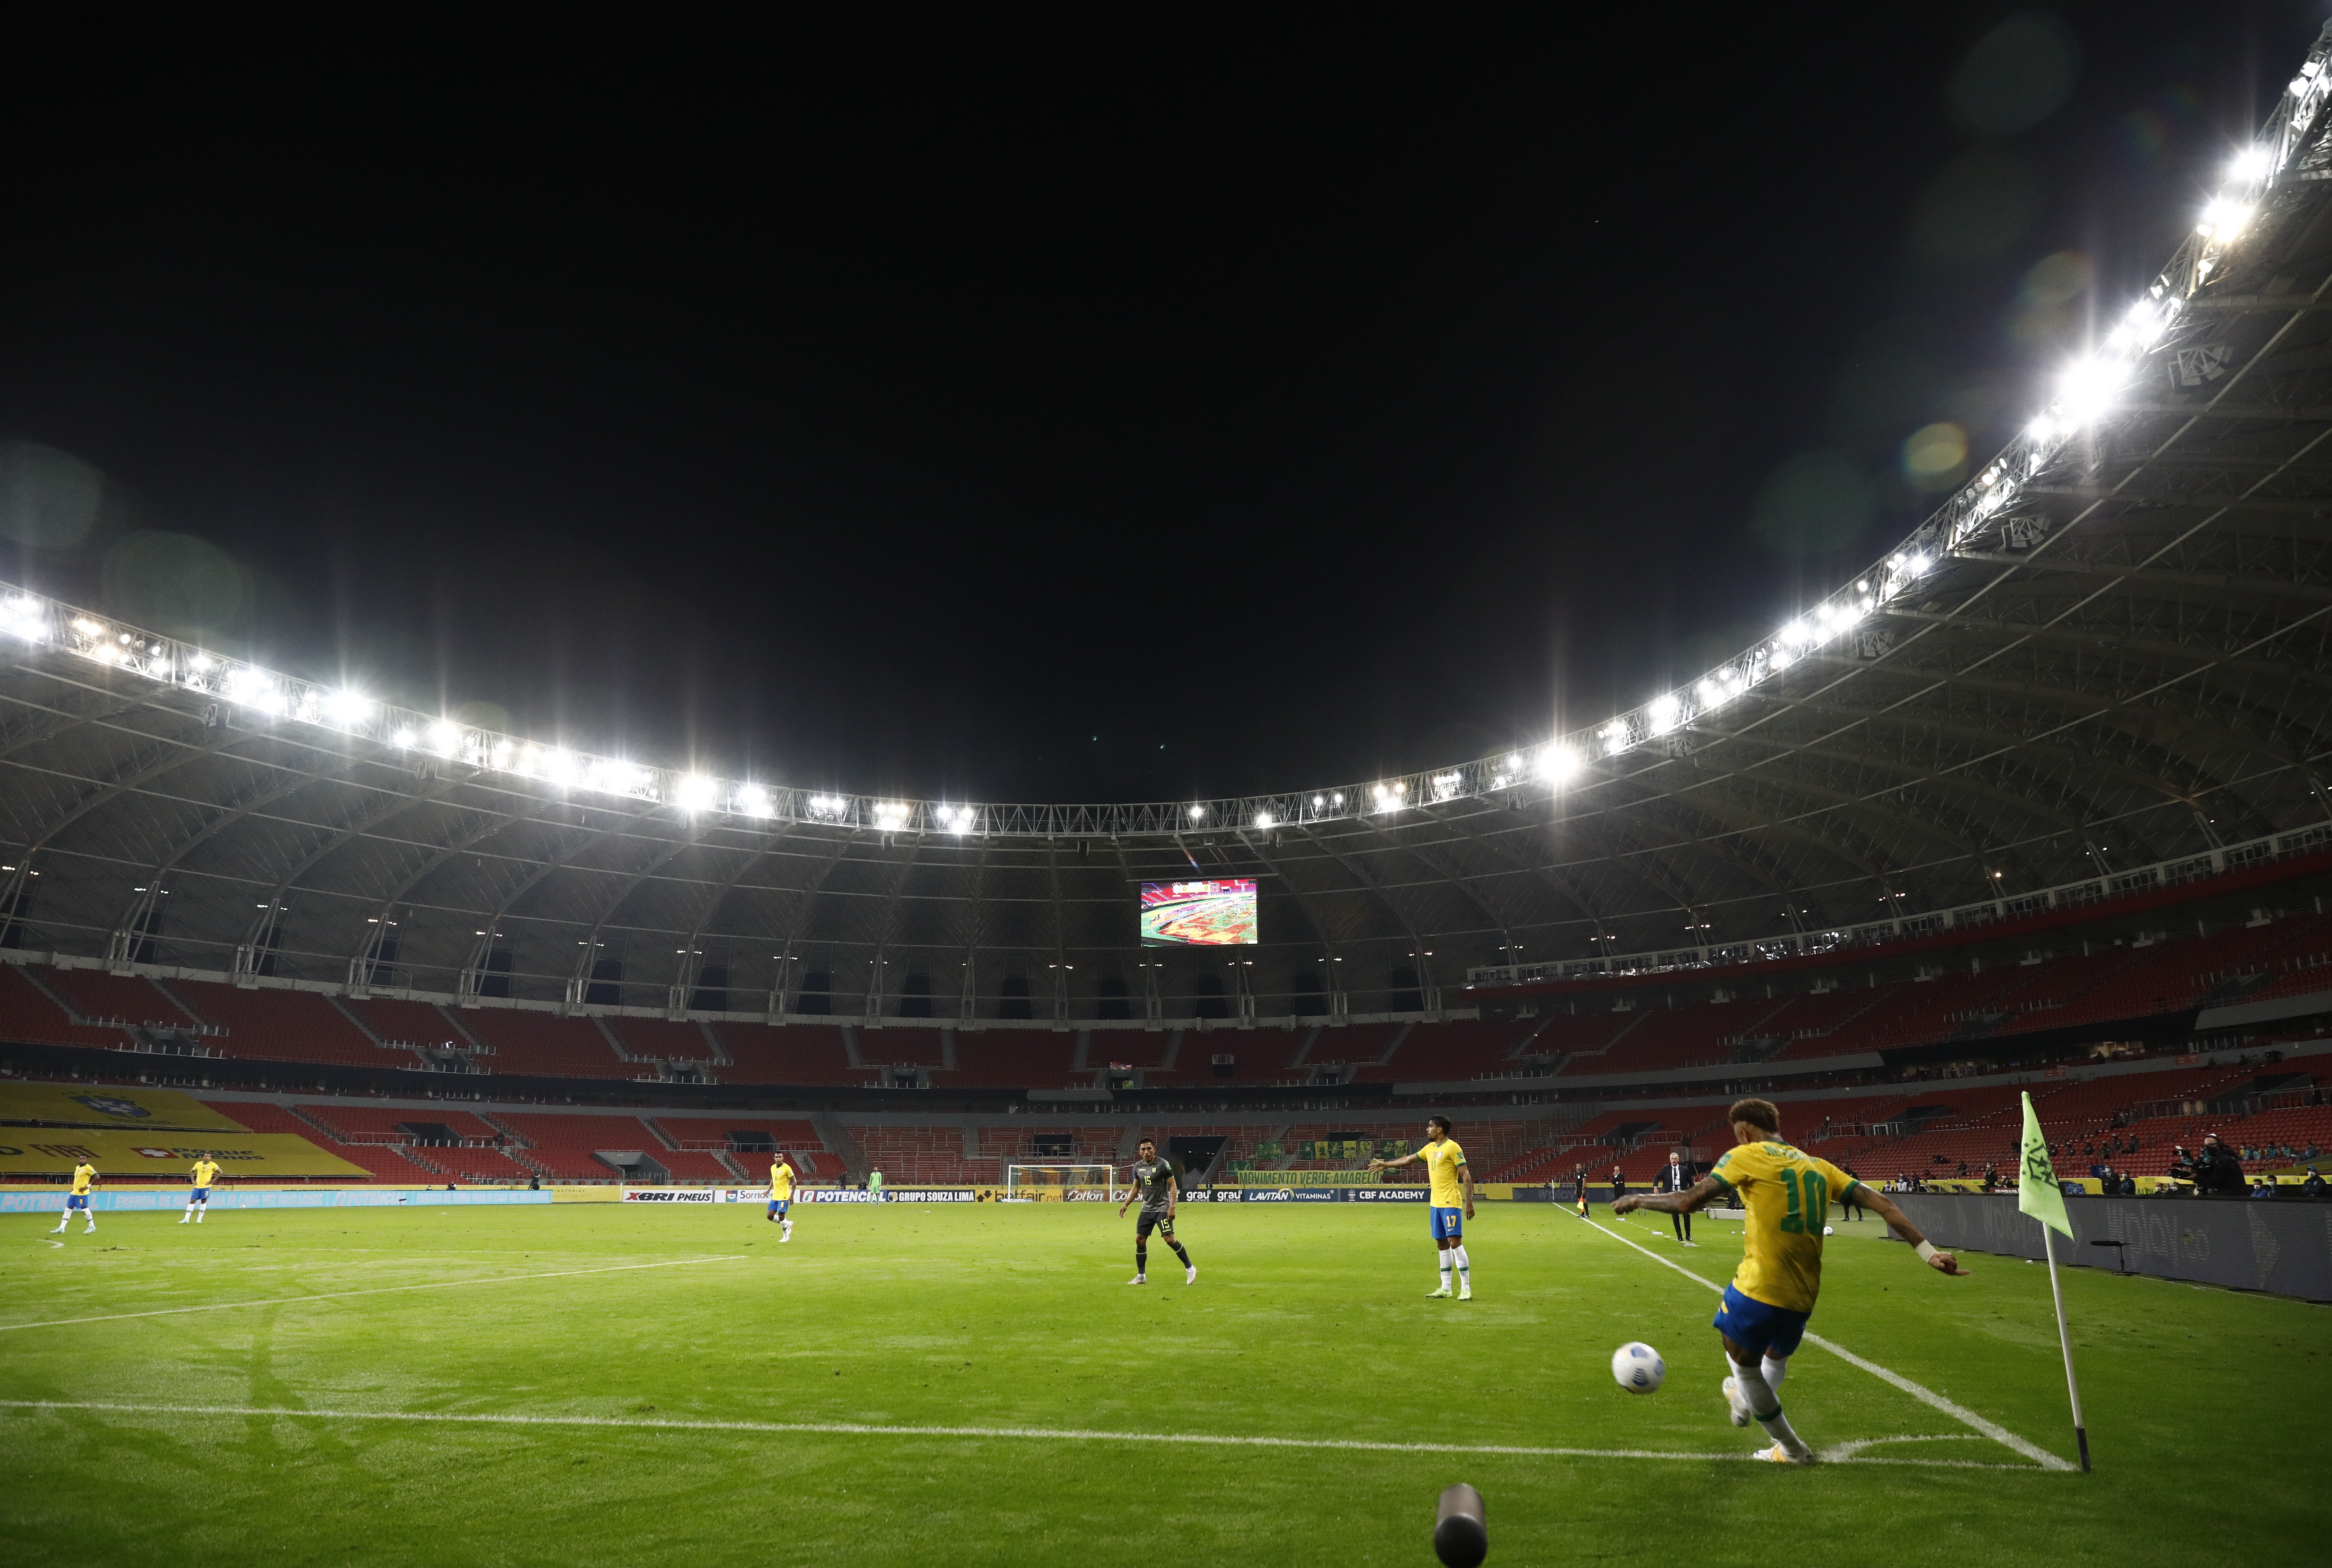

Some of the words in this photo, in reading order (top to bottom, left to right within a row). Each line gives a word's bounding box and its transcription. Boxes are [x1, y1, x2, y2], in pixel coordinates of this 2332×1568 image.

[27, 1144, 101, 1158] FIAT
[1431, 1160, 1436, 1171] 17
[1144, 1176, 1151, 1185] 15
[1239, 1172, 1297, 1184] MOVIMENTO
[1300, 1172, 1331, 1184] VERDE
[158, 1194, 170, 1207] DE
[625, 1192, 675, 1201] XBRI
[816, 1191, 886, 1201] POTENCIAL
[899, 1192, 926, 1201] GRUPO
[927, 1192, 953, 1201] SOUZA
[955, 1192, 974, 1201] LIMA
[1068, 1190, 1103, 1201] Cotton
[1186, 1191, 1209, 1201] grau
[1217, 1191, 1240, 1201] grau
[1249, 1192, 1289, 1200] LAVITAN
[1781, 1168, 1826, 1236] 10
[1160, 1219, 1170, 1229] 15
[1446, 1215, 1457, 1227] 17
